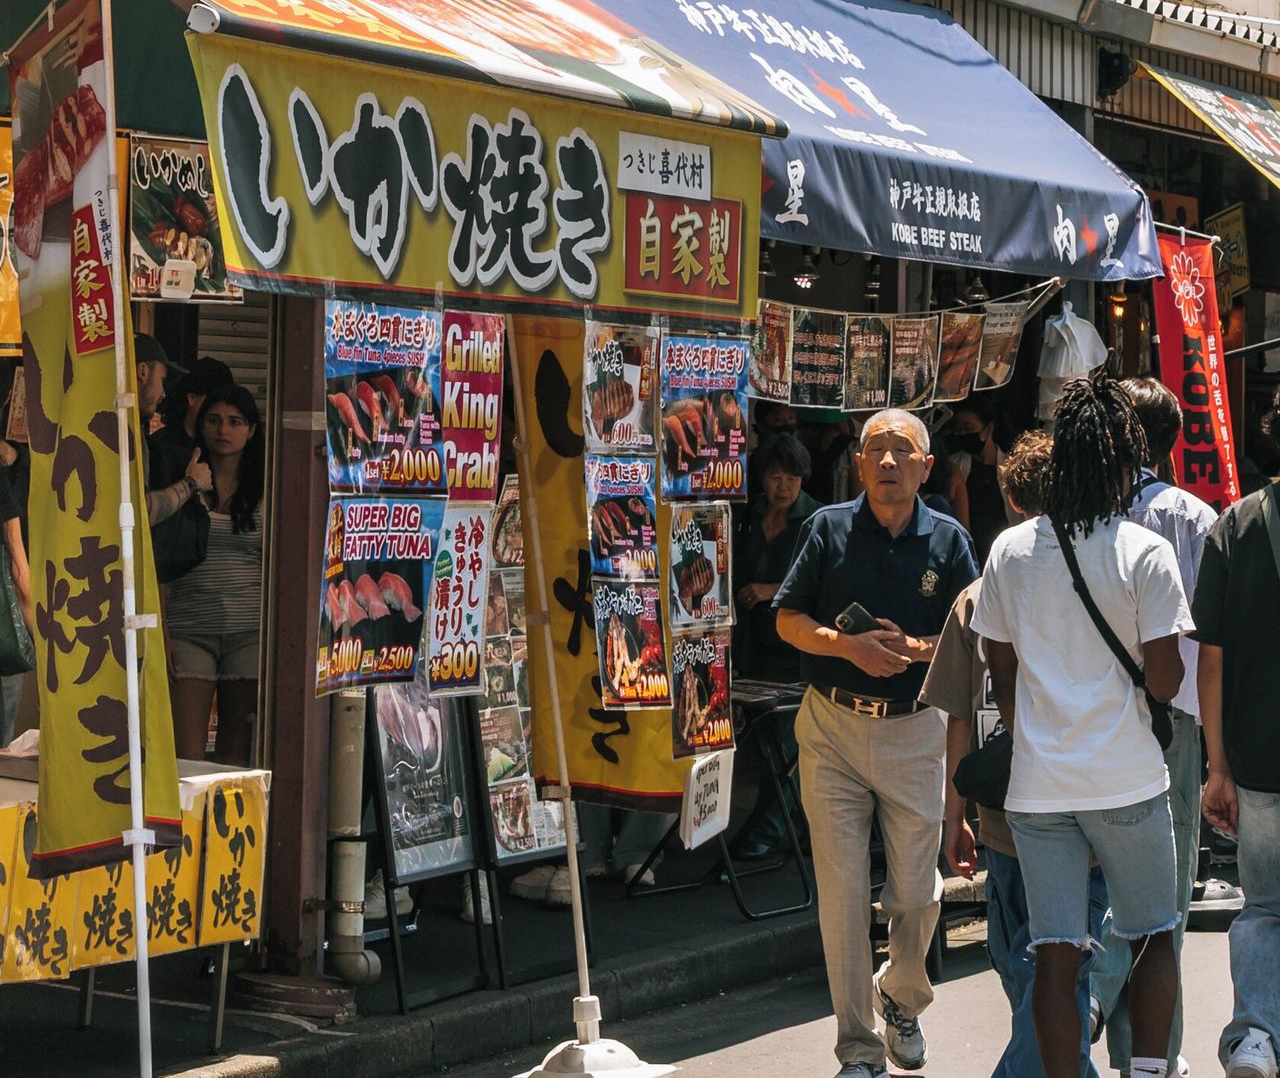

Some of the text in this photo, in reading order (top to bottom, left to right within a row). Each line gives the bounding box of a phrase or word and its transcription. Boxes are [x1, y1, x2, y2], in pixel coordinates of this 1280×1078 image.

[134, 146, 210, 198] いかめし
[217, 61, 611, 300] いか焼き
[623, 145, 705, 191] つきじ喜代村
[775, 158, 809, 227] 星
[889, 177, 981, 222] 神戸牛正規取扱店
[639, 198, 732, 289] 自家製
[892, 222, 983, 254] KOBE BEEF STEAK
[1053, 203, 1124, 268] 肉 星
[72, 218, 114, 344] 自家製
[332, 307, 436, 350] 本まぐろ四貫にぎり
[446, 324, 500, 374] Grilled
[337, 345, 352, 359] Blue
[354, 347, 362, 359] fin
[364, 349, 381, 362] Tuna
[383, 350, 405, 365] 4pieces
[665, 344, 745, 373] 本まぐろ四貫にぎり
[690, 376, 703, 387] Tuna
[721, 377, 736, 389] SUSHI
[443, 381, 498, 441] King
[1182, 334, 1220, 485] KOBE
[366, 449, 440, 481] 1set ¥2,000
[444, 441, 495, 489] Crab
[703, 461, 742, 490] ¥2,000
[626, 485, 644, 495] SUSHI
[347, 505, 420, 531] SUPER BIG
[344, 534, 386, 561] FATTY
[387, 534, 431, 559] TUNA
[468, 515, 484, 608] 冷やし
[451, 521, 466, 637] きゅうり
[435, 579, 451, 641] 漬け
[431, 640, 478, 681] ¥300
[636, 673, 668, 698] ¥2,000
[703, 718, 731, 745] ¥2,000
[211, 785, 257, 934] いか焼き
